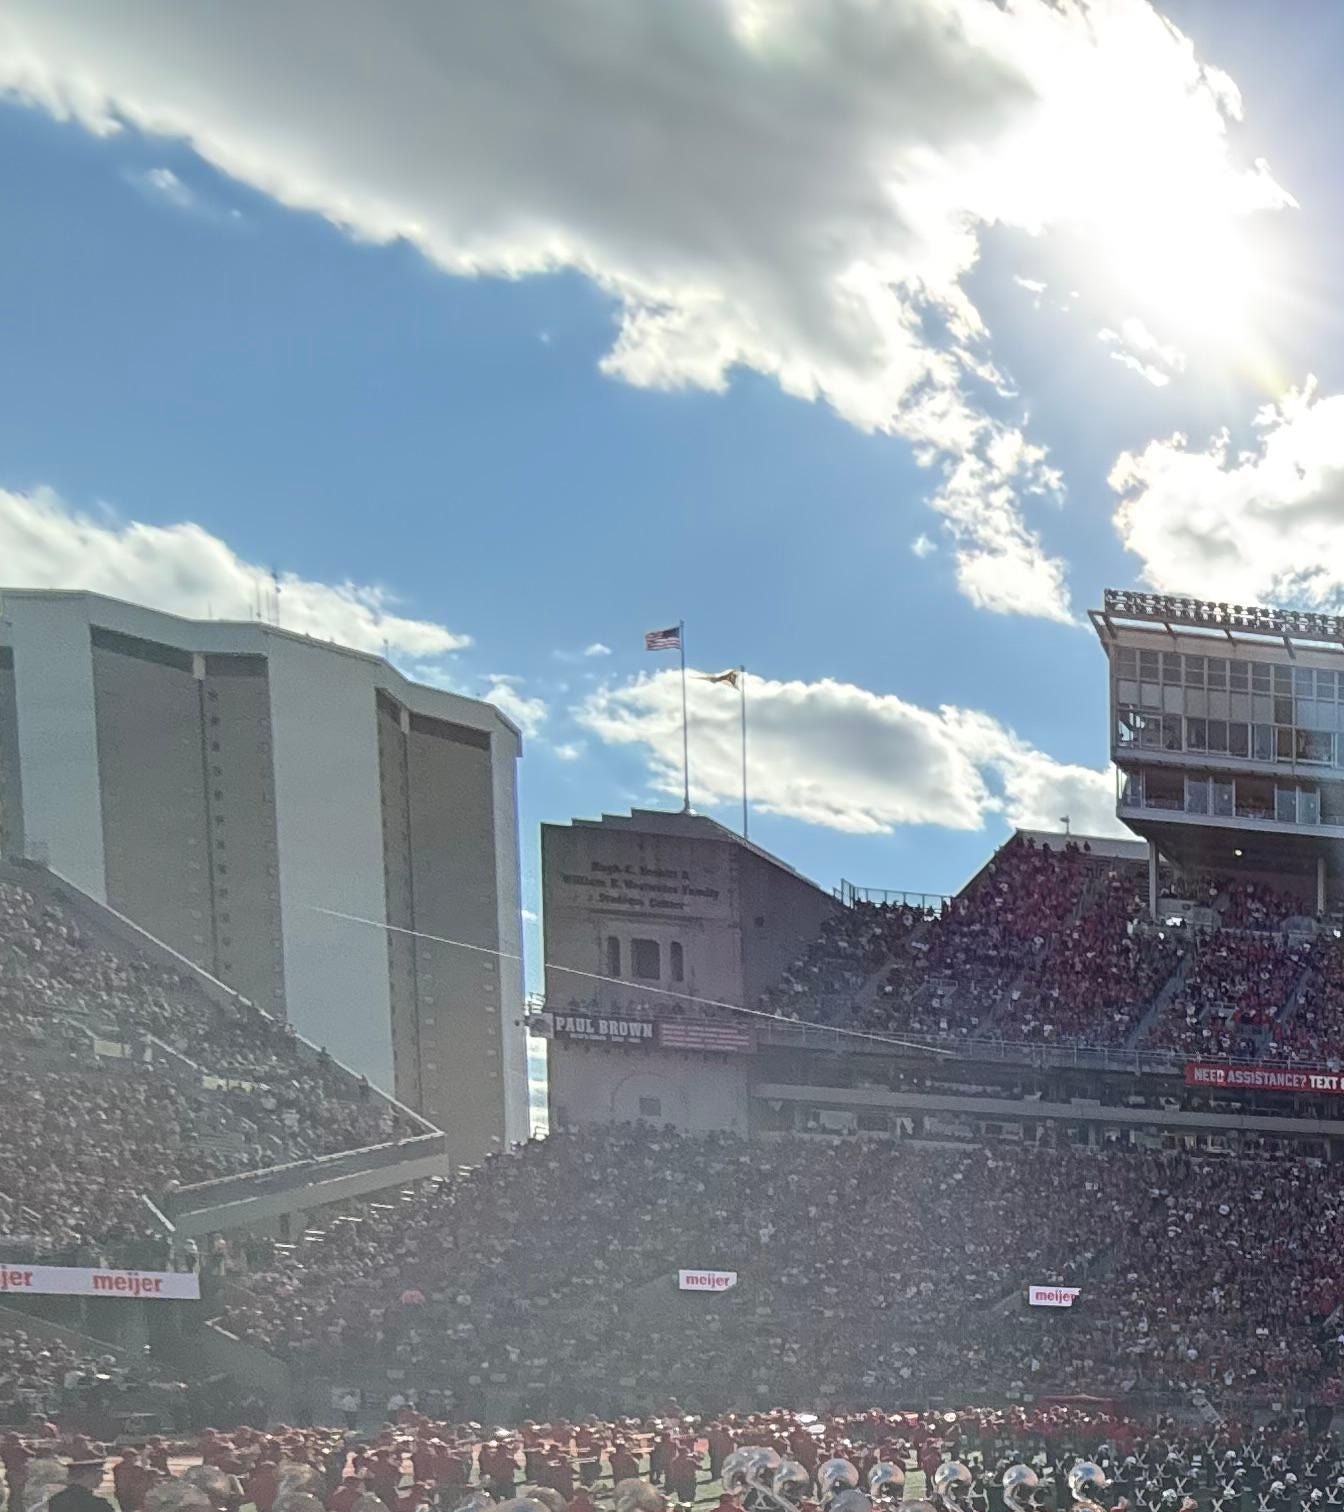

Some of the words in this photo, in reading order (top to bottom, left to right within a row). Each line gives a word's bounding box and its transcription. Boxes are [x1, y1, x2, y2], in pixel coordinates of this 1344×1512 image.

[555, 1016, 595, 1034] PAUL
[599, 1020, 652, 1038] BROWN
[1194, 1067, 1225, 1083] NEED
[1227, 1070, 1307, 1088] ASSISTANCE?
[1309, 1074, 1338, 1090] TEXT
[93, 1271, 164, 1296] meijer
[685, 1272, 731, 1290] meijer
